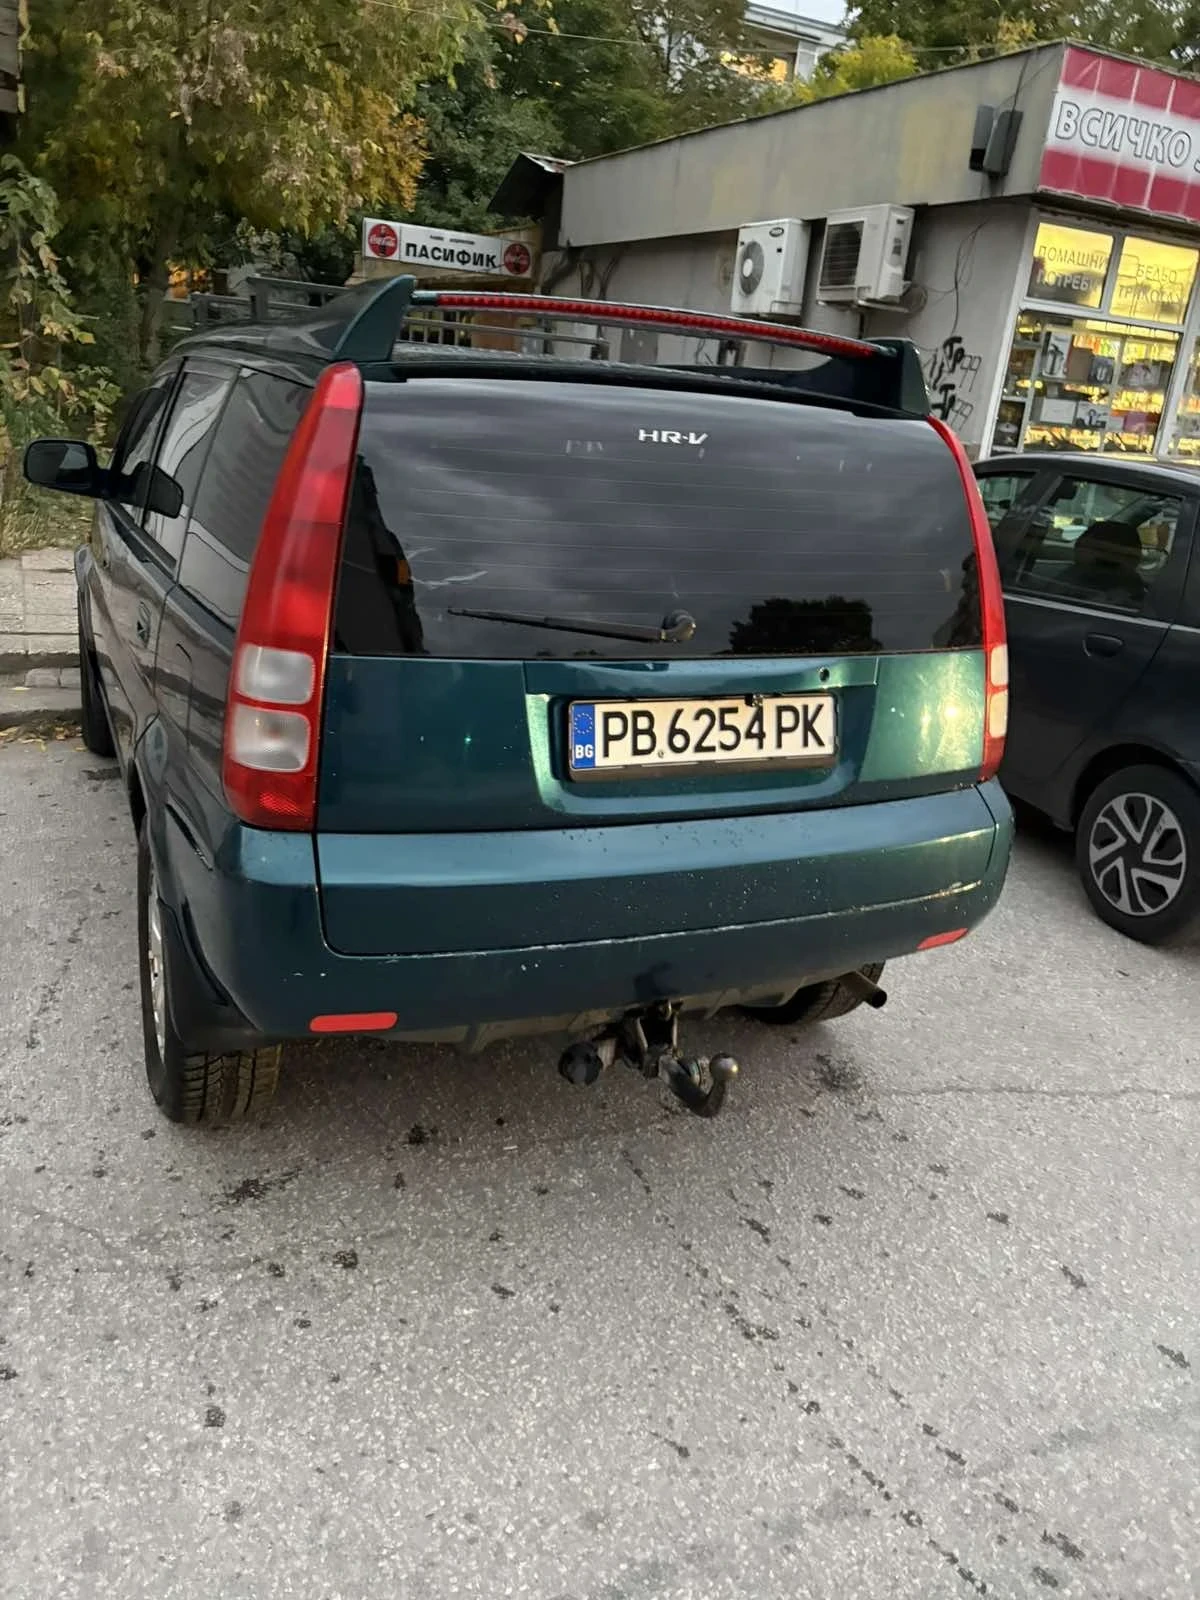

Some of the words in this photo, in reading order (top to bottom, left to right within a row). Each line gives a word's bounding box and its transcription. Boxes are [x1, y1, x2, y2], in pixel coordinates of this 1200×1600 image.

[1055, 100, 1192, 168] ВСИЧКО
[405, 242, 497, 268] ПАСИФИК
[638, 428, 708, 444] HR-V
[602, 709, 657, 758] PB
[667, 703, 766, 754] 6254
[775, 703, 825, 749] PK
[575, 744, 594, 759] BG
